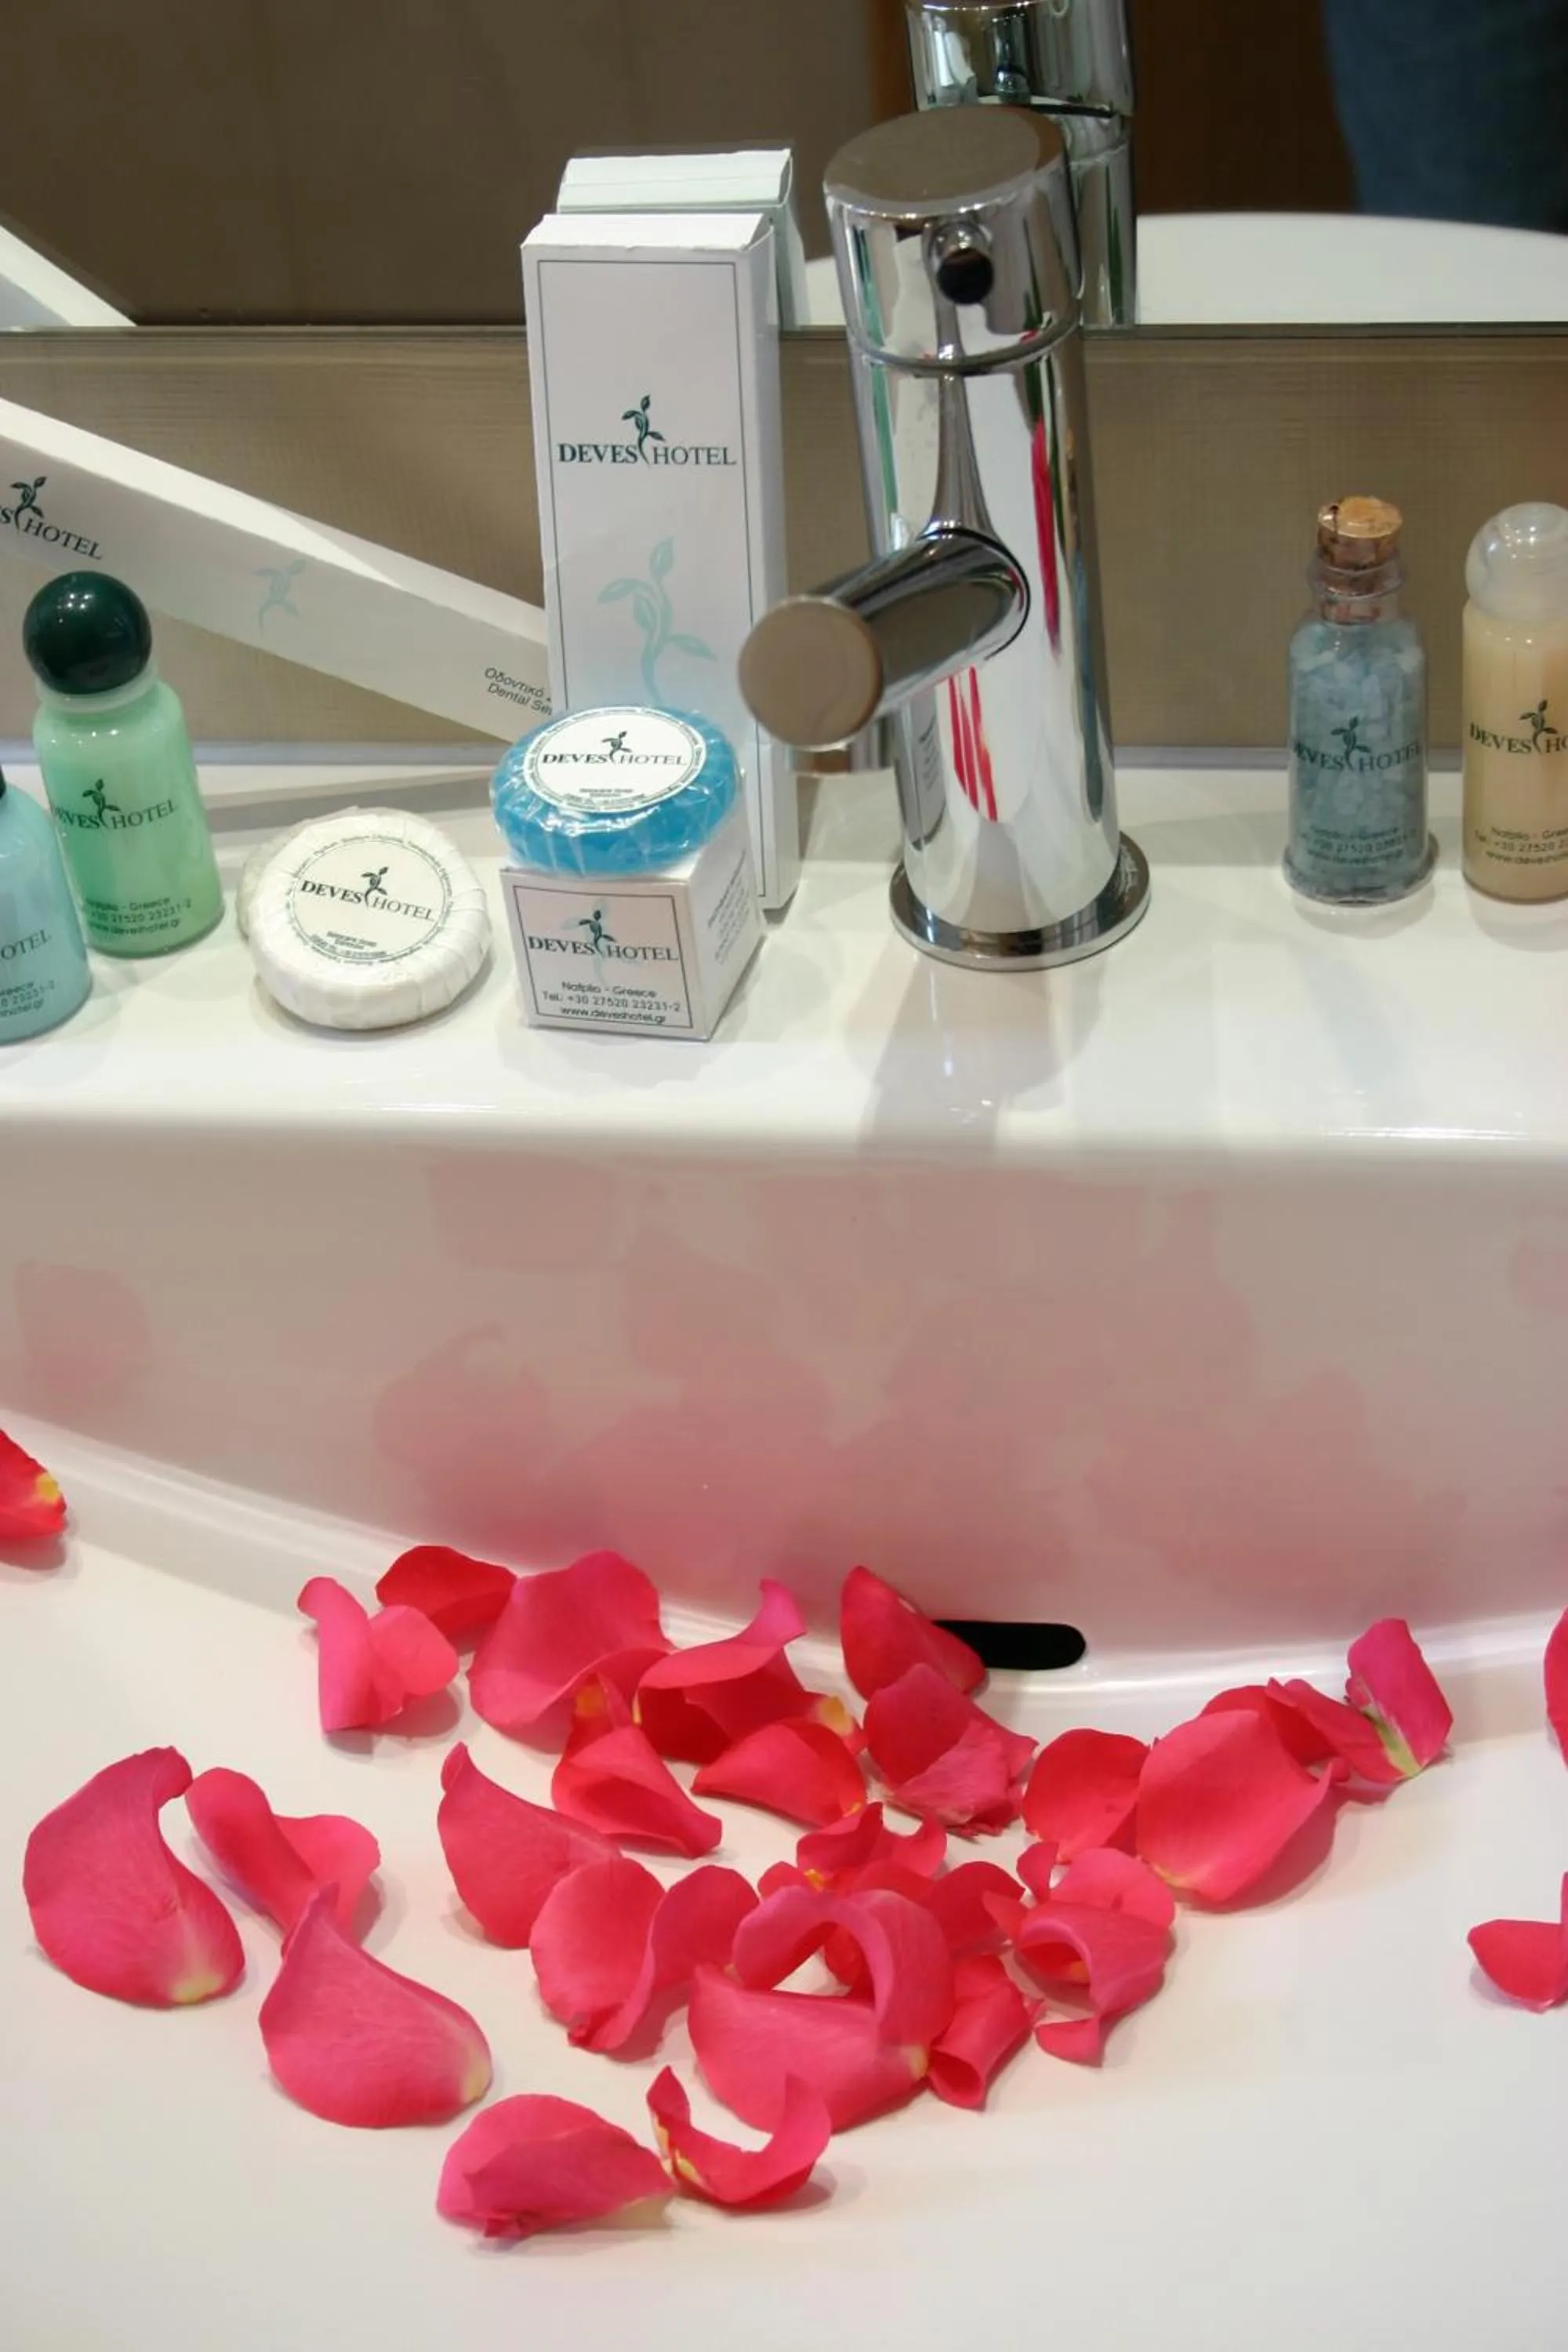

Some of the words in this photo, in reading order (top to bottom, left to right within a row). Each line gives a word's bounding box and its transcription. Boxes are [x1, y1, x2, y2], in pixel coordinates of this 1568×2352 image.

[557, 443, 638, 464] DEVES
[652, 446, 737, 466] HOTEL
[24, 517, 103, 561] HOTEL
[1469, 720, 1532, 754] DEVES
[543, 753, 608, 764] DEVES
[619, 753, 688, 766] HOTEL
[111, 798, 179, 829] HOTEL
[300, 880, 362, 905] DEVES
[372, 896, 435, 922] HOTEL
[0, 929, 52, 960] OTEL
[527, 935, 596, 956] DEVES
[607, 944, 680, 962] HOTEL
[593, 995, 628, 1008] 27520
